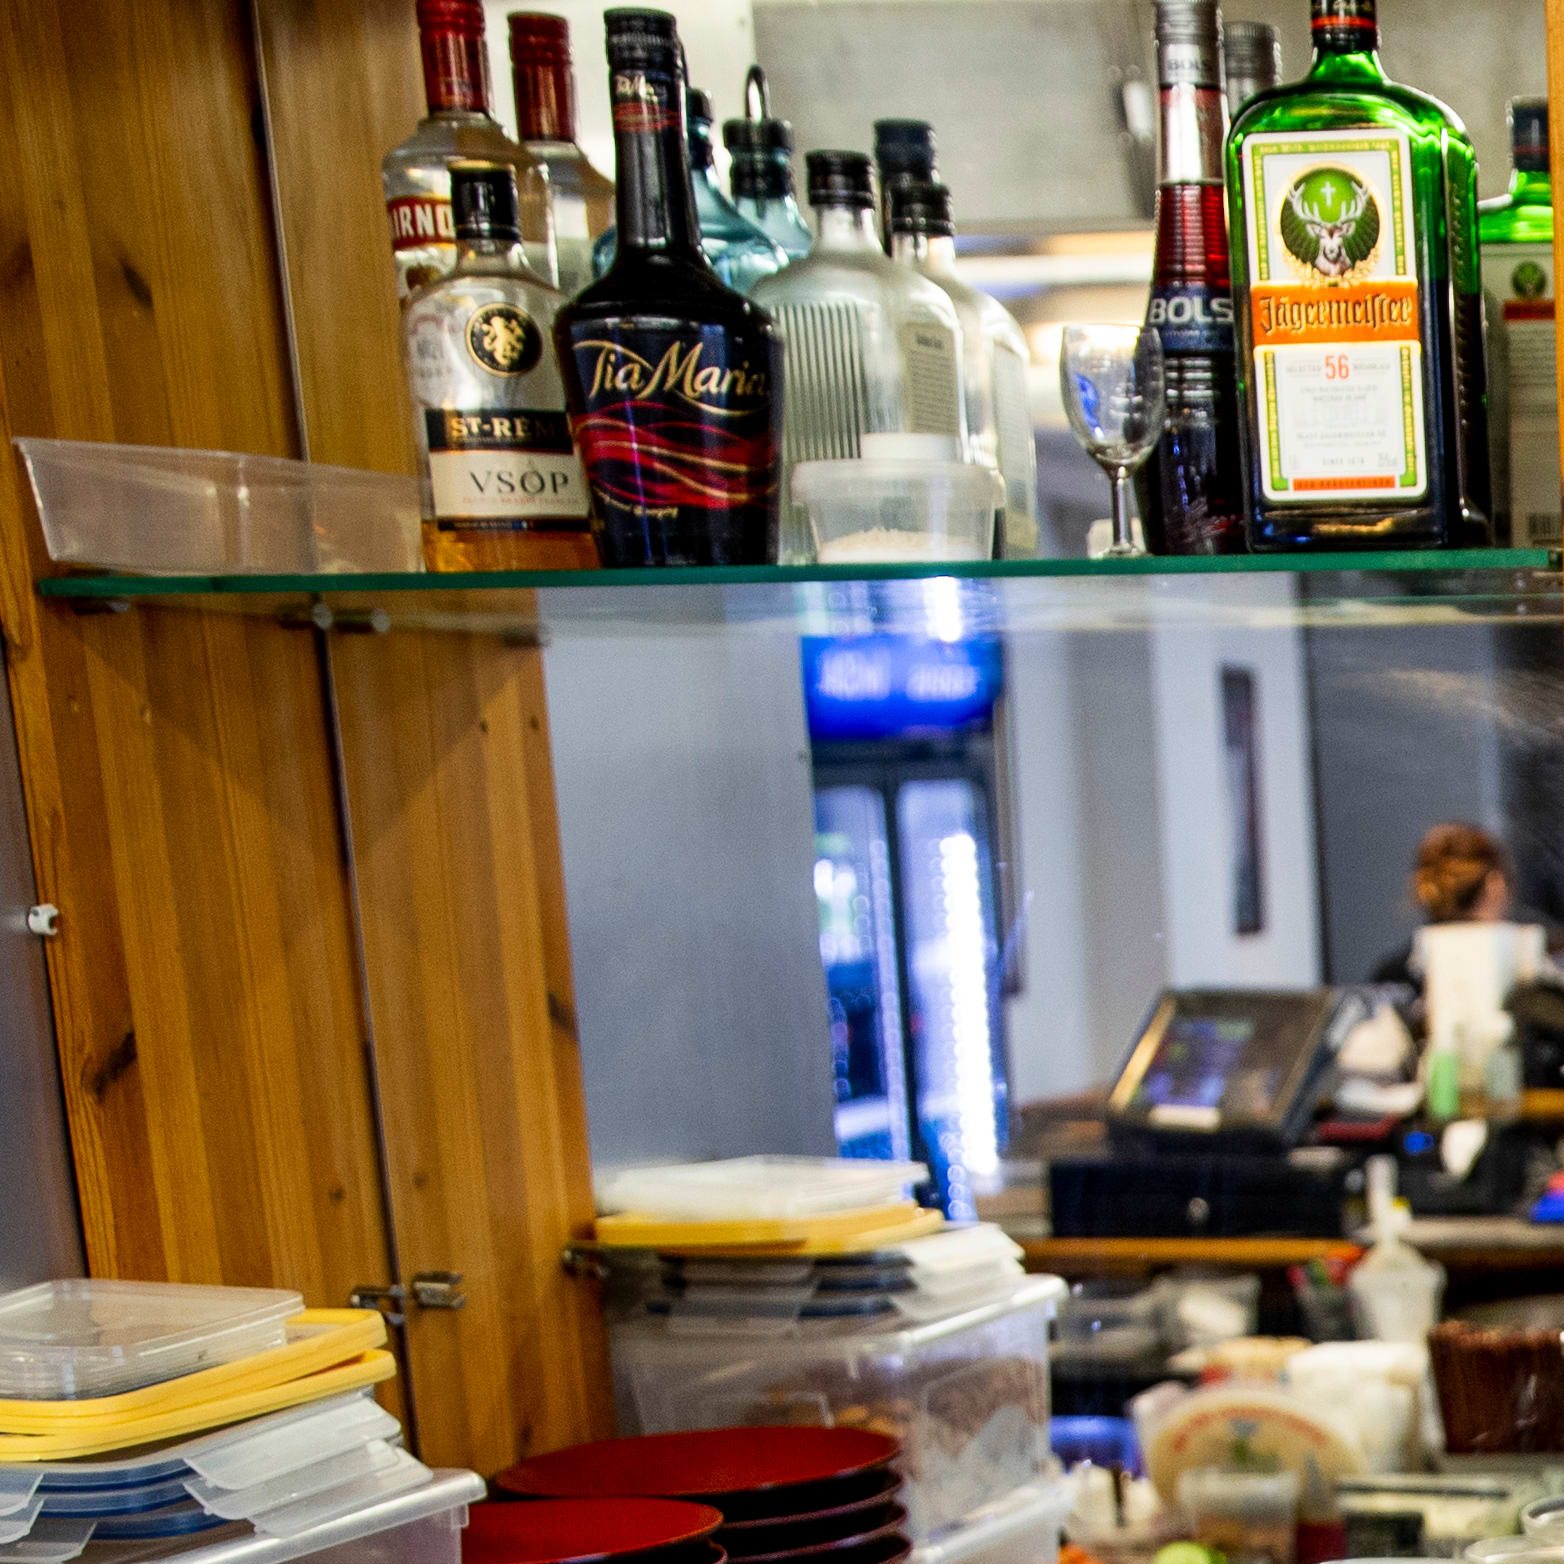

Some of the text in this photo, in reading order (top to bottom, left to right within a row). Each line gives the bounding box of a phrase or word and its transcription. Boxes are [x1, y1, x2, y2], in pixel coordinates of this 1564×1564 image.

[390, 202, 456, 239] IRNO
[1150, 296, 1234, 326] BOLS
[573, 339, 767, 402] Tia Maria
[1324, 353, 1350, 380] 56
[470, 468, 570, 495] VSOP
